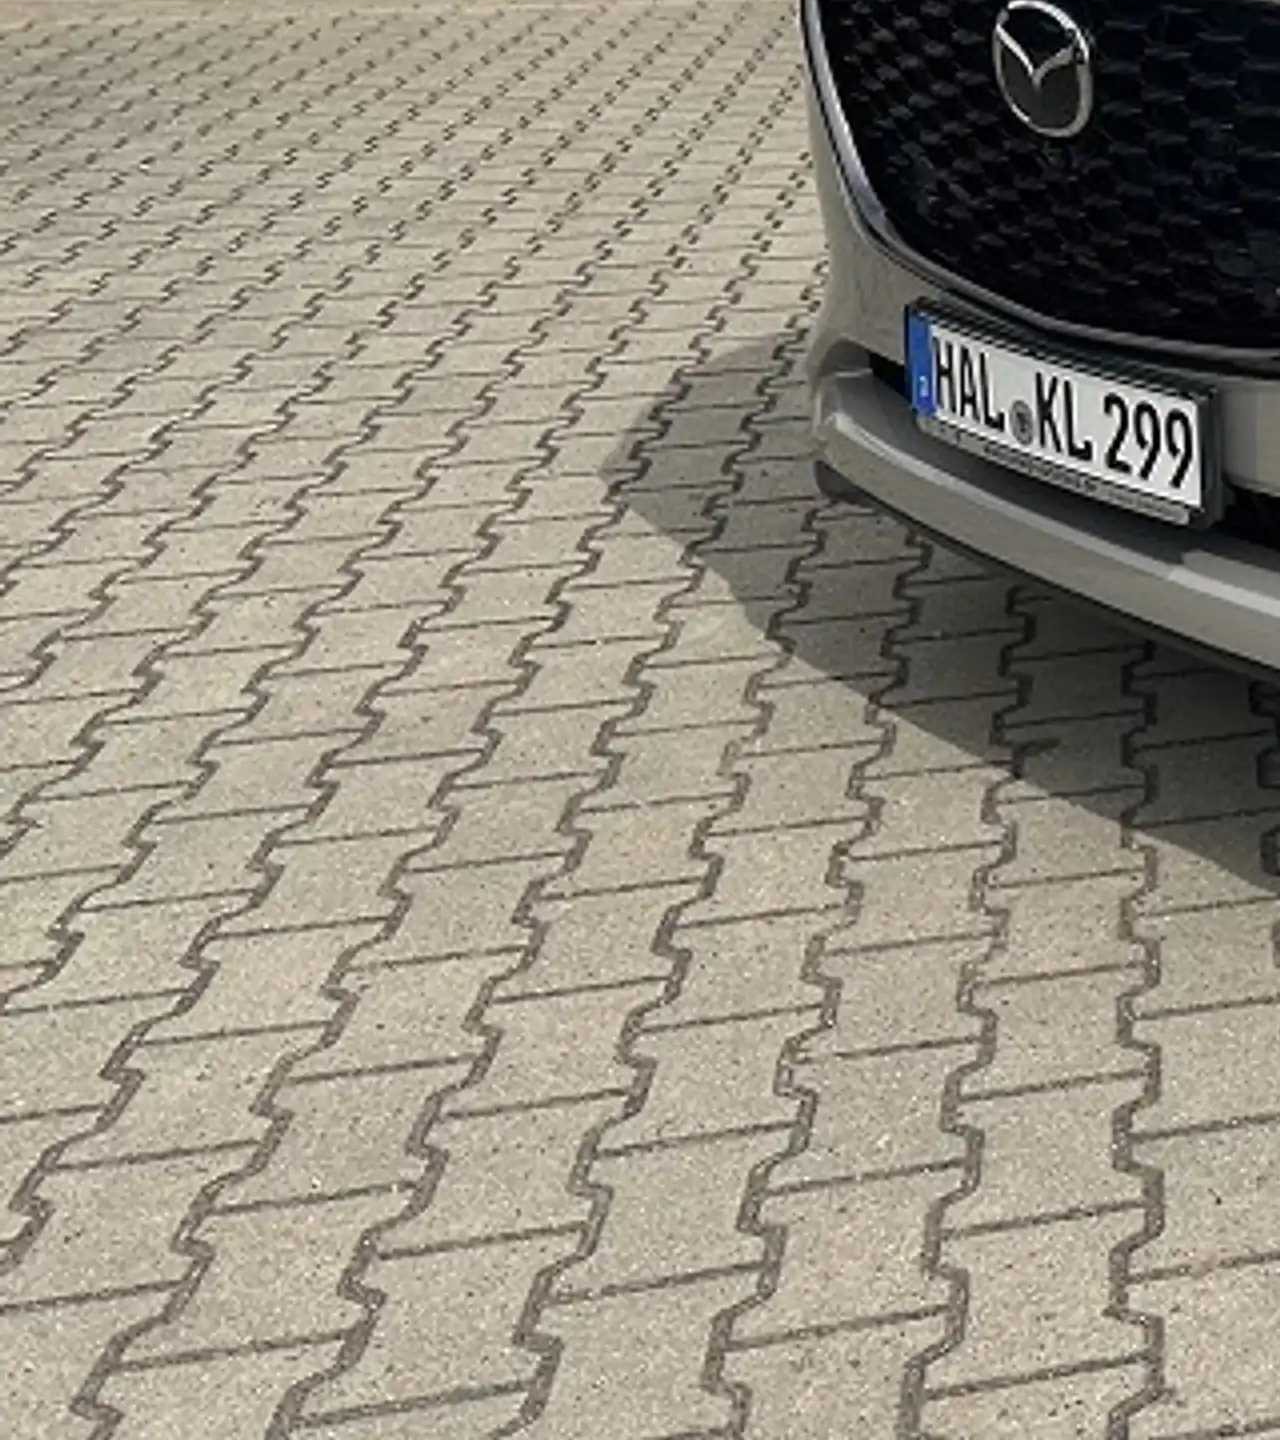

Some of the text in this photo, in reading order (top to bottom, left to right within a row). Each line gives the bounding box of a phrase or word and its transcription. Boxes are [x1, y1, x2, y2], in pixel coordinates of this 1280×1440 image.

[932, 336, 1004, 433] HAL
[1035, 371, 1093, 461] KL
[1104, 391, 1193, 489] 299
